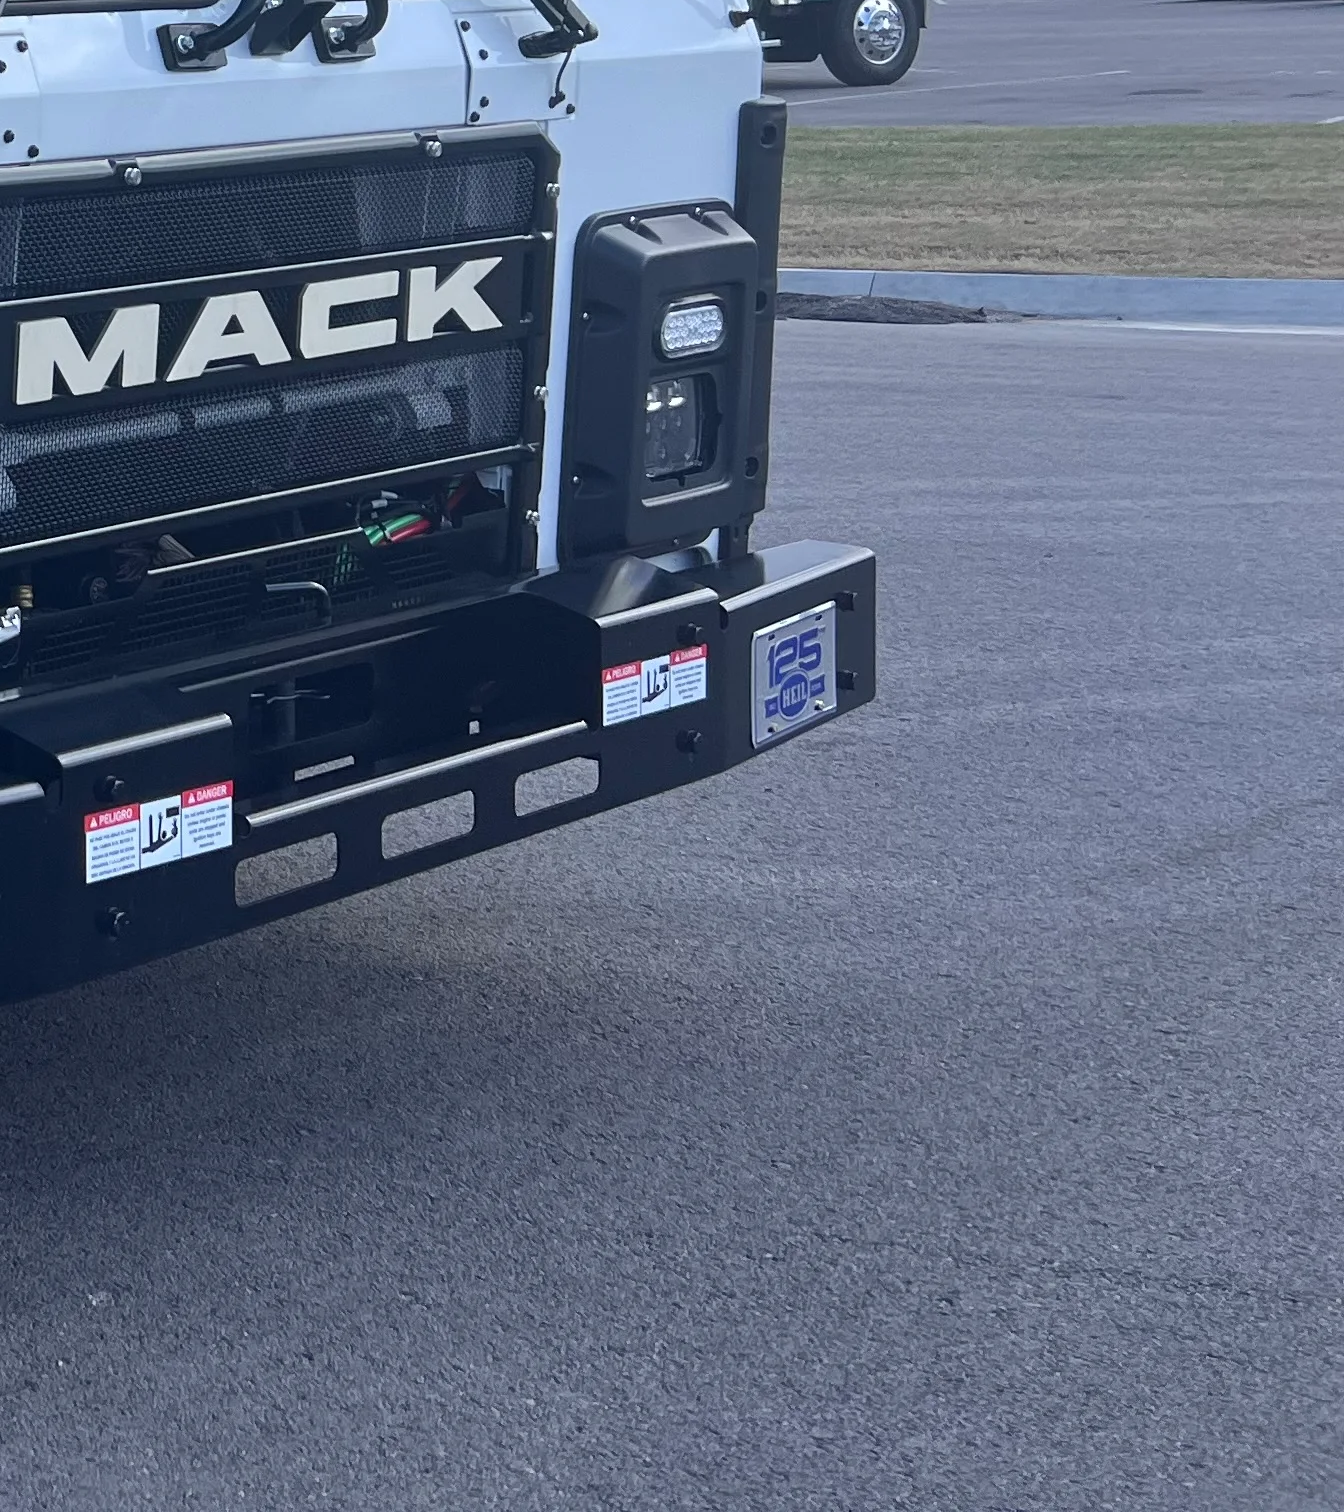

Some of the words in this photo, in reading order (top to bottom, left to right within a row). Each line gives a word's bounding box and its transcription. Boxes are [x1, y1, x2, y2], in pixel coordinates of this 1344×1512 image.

[16, 256, 503, 405] MACK
[766, 627, 823, 689] 125
[782, 681, 808, 709] HEIL
[196, 784, 227, 802] DANGER
[99, 807, 133, 826] PELIGRO
